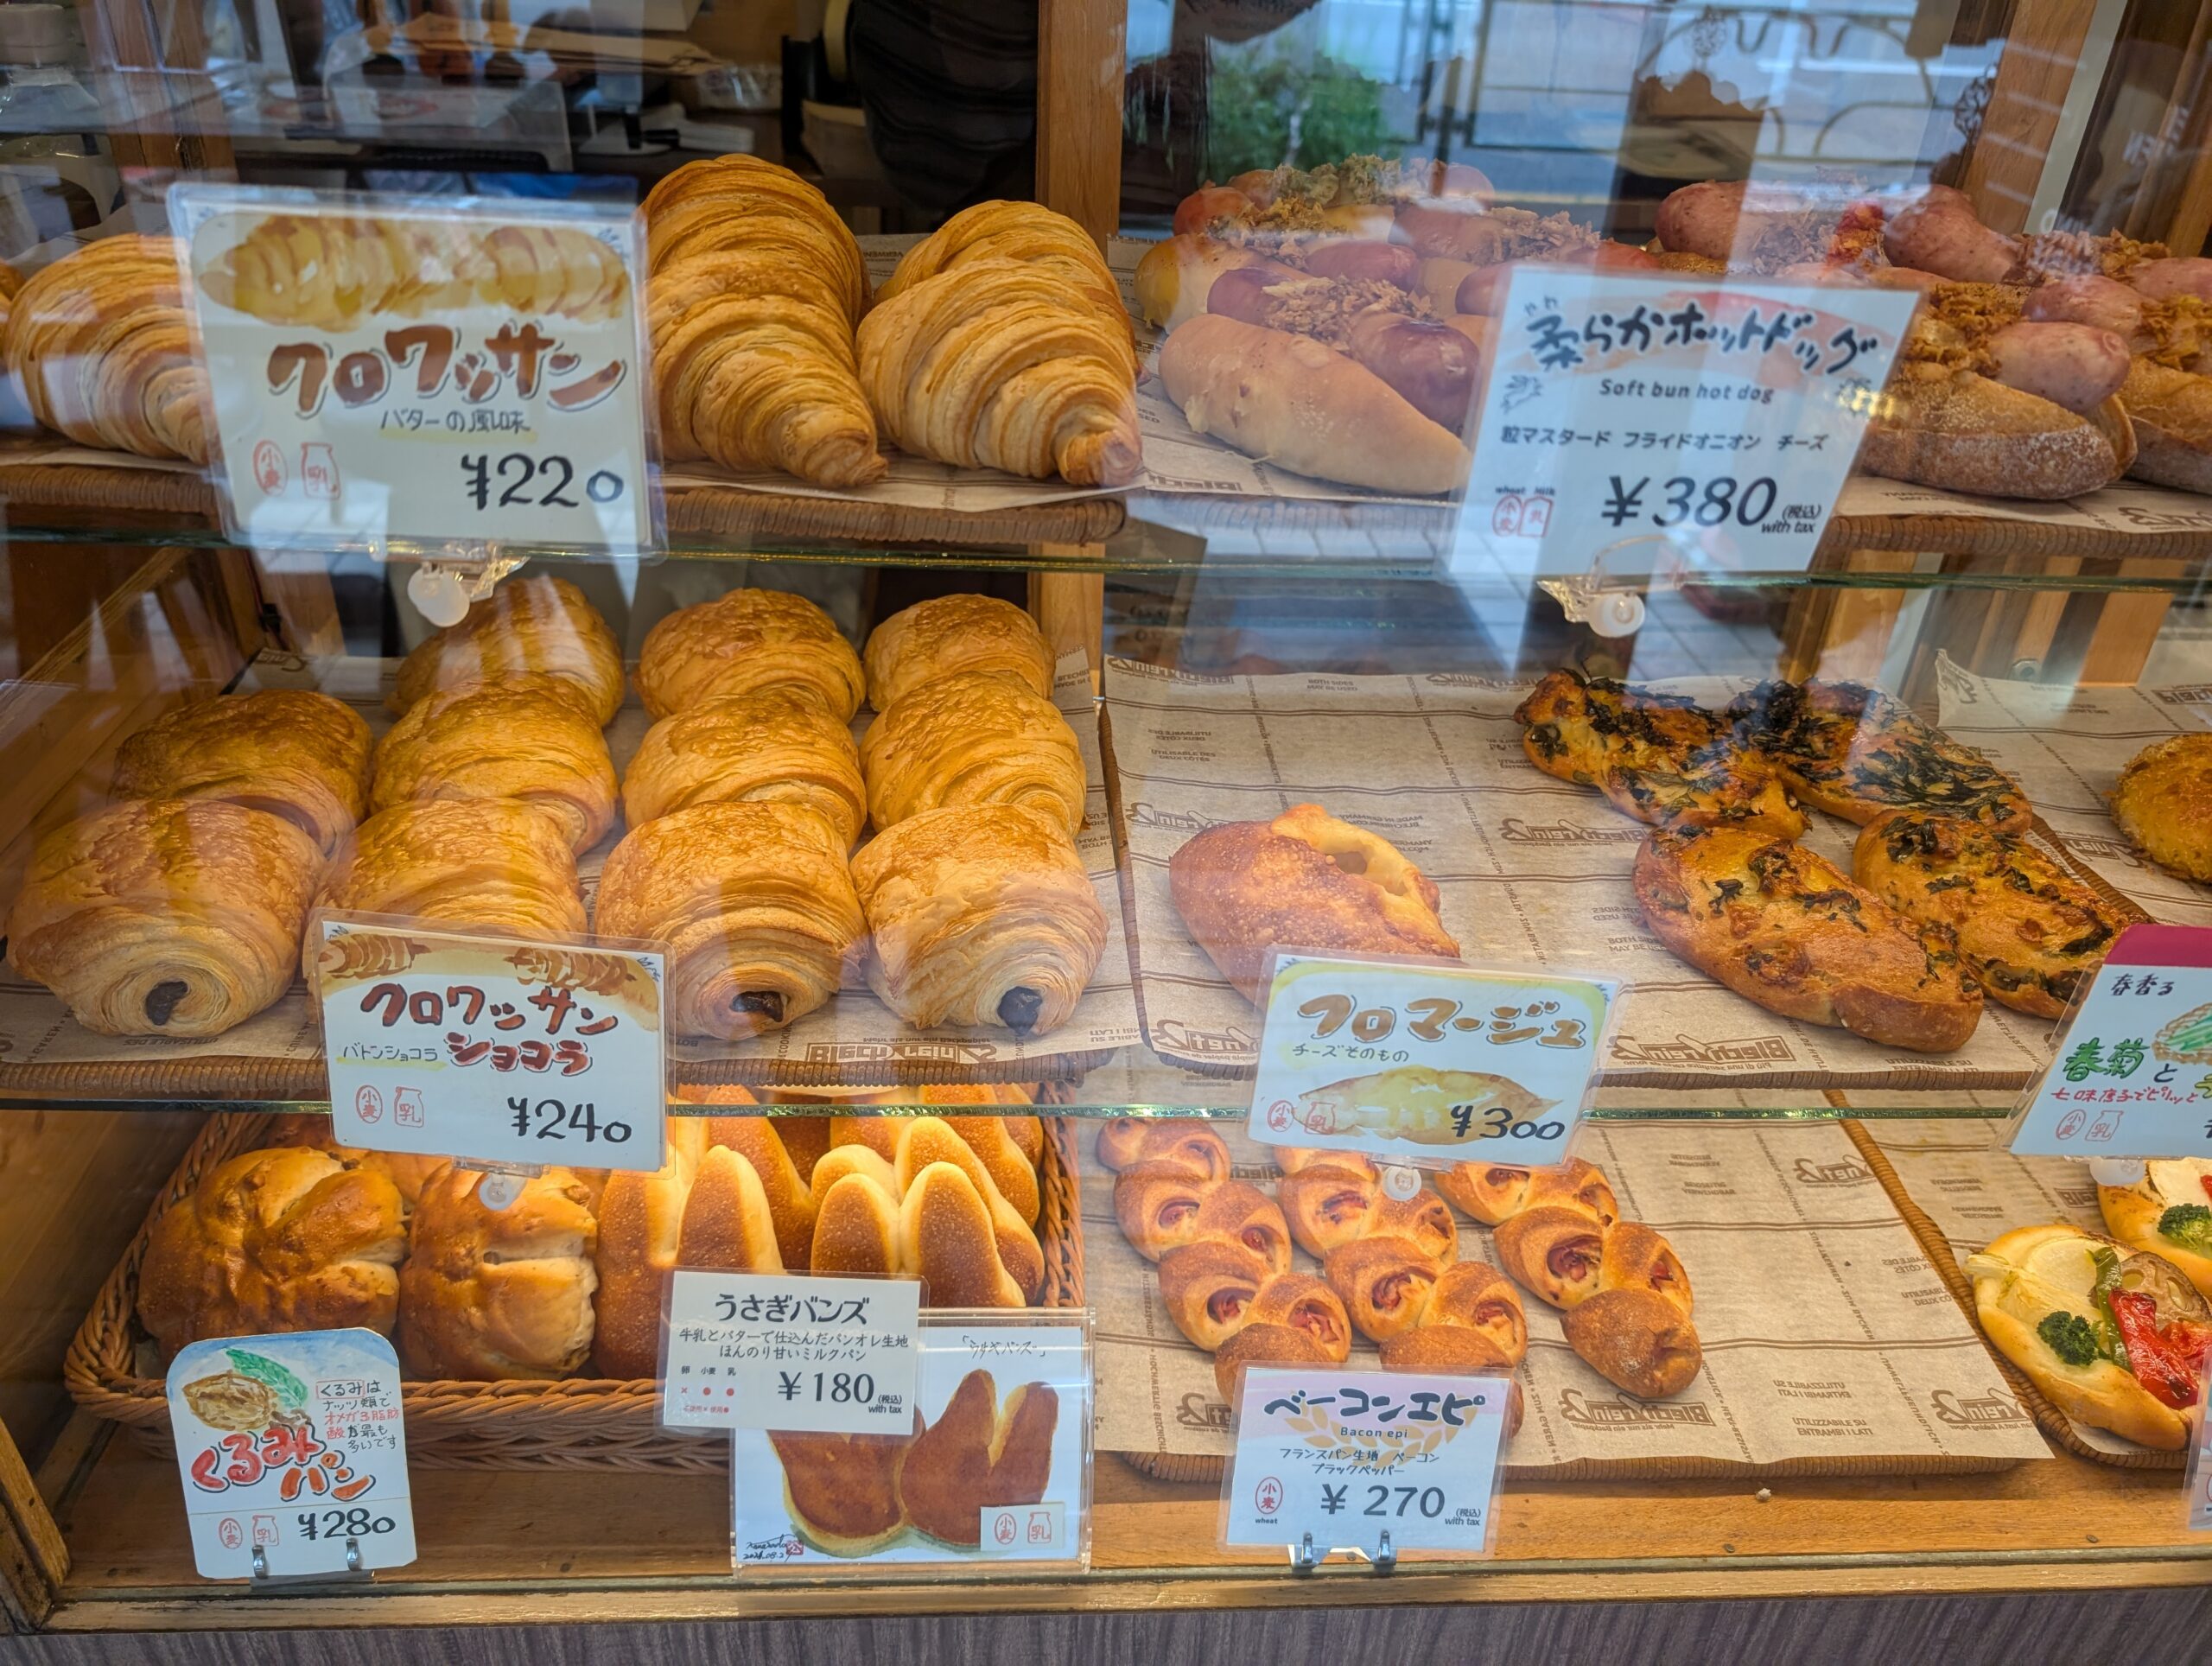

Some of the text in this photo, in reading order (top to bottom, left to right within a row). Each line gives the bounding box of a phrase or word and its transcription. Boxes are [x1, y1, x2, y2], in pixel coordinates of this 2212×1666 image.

[1526, 302, 1878, 372] 柔らかホットドッグ
[267, 321, 627, 420] クロワッサン
[1599, 378, 1774, 404] Soft bun hot dog
[381, 410, 532, 433] バターの風味
[1624, 429, 1762, 450] フライドオニオン
[1777, 434, 1828, 451] チーズ
[461, 454, 624, 511] ¥220
[1761, 520, 1815, 534] with tax
[360, 983, 618, 1035] クロワッサン
[1298, 993, 1586, 1050] フロマージュ
[444, 1032, 593, 1076] ショコラ
[1293, 1044, 1409, 1063] チーズそのもの
[361, 1091, 378, 1120] 小麦
[507, 1097, 632, 1143] ¥240
[1451, 1104, 1566, 1141] ¥300
[715, 1293, 870, 1326] うさぎバンズ
[679, 1328, 909, 1350] 牛乳とバターで仕込んだパンオレ生地
[720, 1345, 867, 1363] ほんのり甘いミルクパン
[321, 1380, 381, 1397] くるみは
[878, 1394, 902, 1404] (税込)
[323, 1391, 392, 1411] ナッツ類で
[868, 1403, 902, 1414] with tax
[1263, 1388, 1486, 1426] ベーコンエピ
[1340, 1427, 1408, 1440] Bacon epi
[1792, 1417, 1853, 1427] UTILIZZABILE
[1797, 1428, 1842, 1436] ENTRAMBI
[347, 1434, 397, 1453] 多いです
[1280, 1448, 1379, 1461] フランスパン生地
[191, 1425, 327, 1493] くるみ
[280, 1451, 377, 1502] パン
[1262, 1483, 1276, 1510] 小麦
[298, 1508, 396, 1541] ¥280
[999, 1518, 1012, 1542] 小麦
[1032, 1524, 1050, 1542] 乳
[1445, 1517, 1465, 1526] with
[223, 1521, 238, 1547] 小麦
[257, 1528, 276, 1543] 乳
